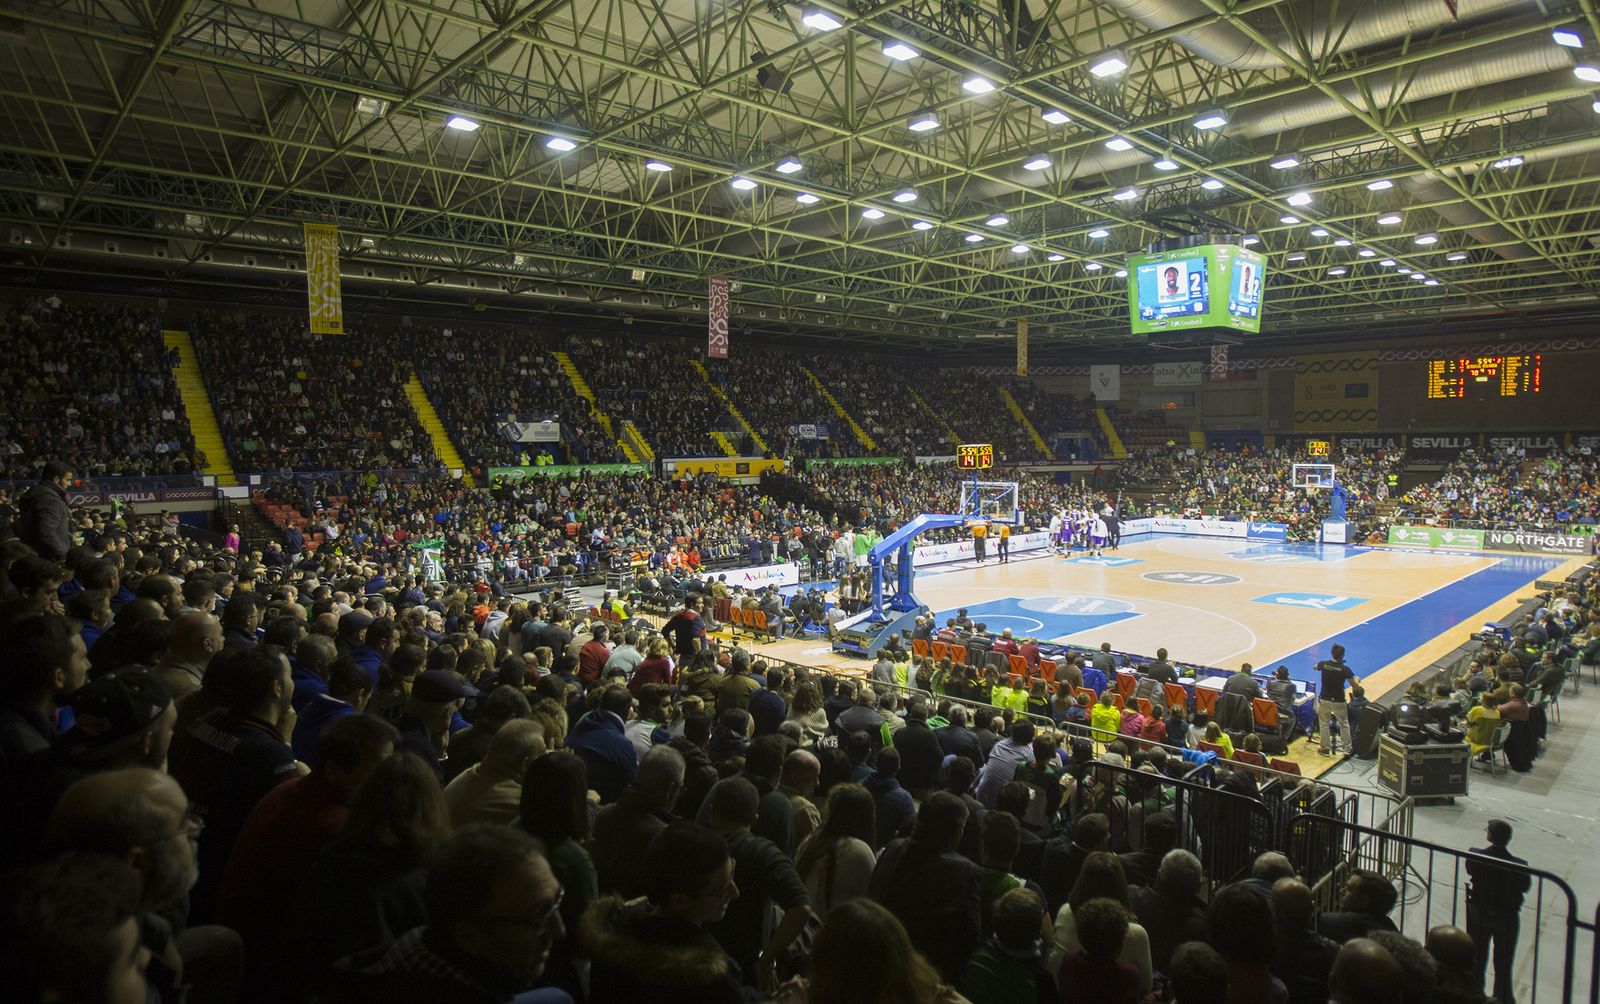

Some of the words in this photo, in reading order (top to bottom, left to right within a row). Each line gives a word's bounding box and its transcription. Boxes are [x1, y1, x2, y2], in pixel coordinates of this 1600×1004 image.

[1190, 273, 1201, 291] 2
[1340, 438, 1395, 448] SEVILLA
[1412, 437, 1472, 449] SEVILLA
[1489, 437, 1558, 449] SEVILLA
[964, 455, 974, 466] 14
[108, 492, 156, 503] SEVILLA
[1491, 533, 1585, 548] NORTHGATE
